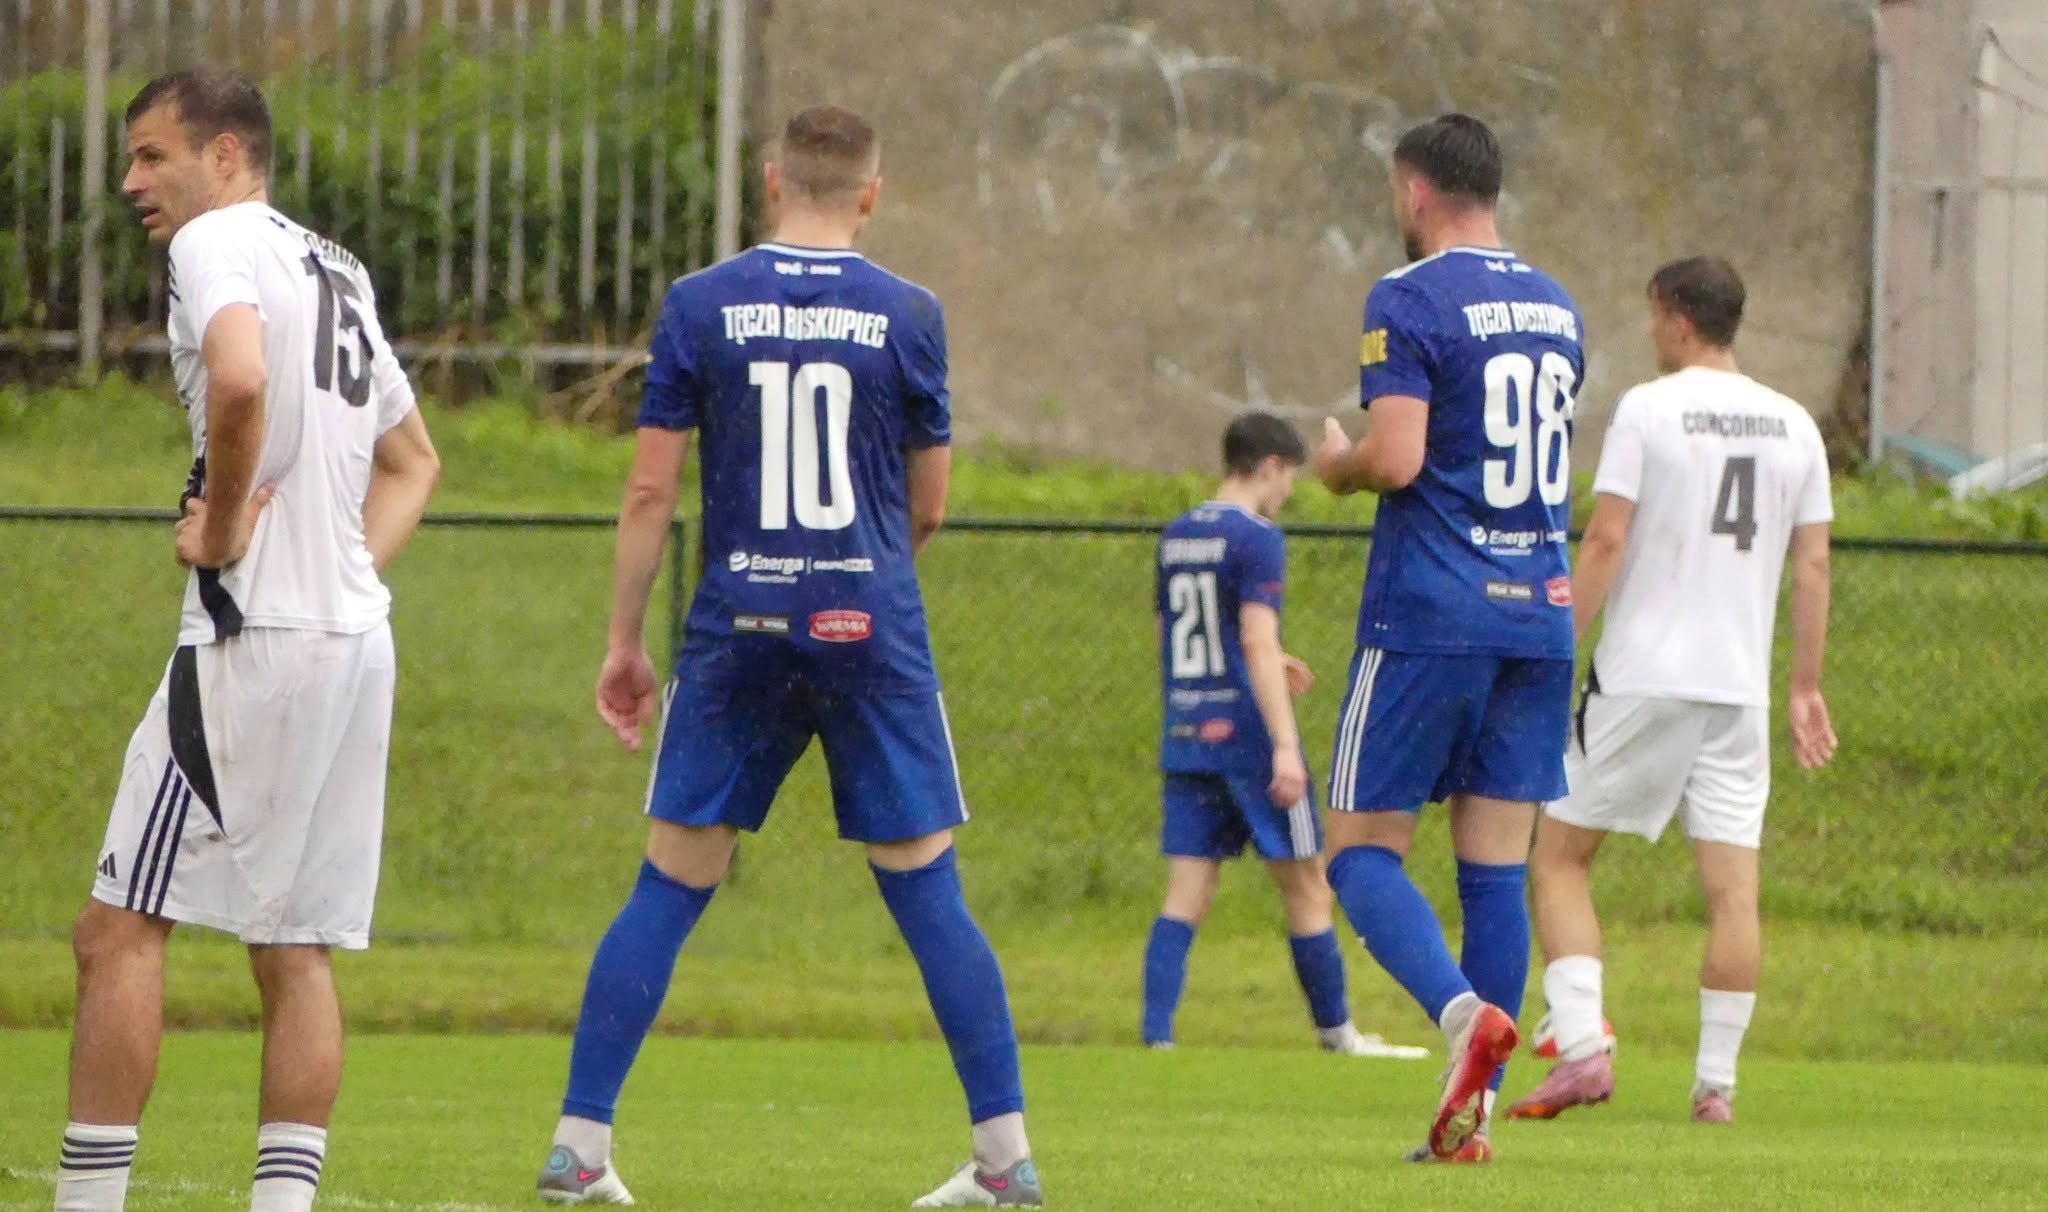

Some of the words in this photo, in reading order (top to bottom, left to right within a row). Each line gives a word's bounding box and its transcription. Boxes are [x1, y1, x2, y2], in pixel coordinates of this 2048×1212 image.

[300, 250, 375, 408] 15
[721, 303, 781, 345] TĘCZA
[785, 306, 888, 348] BISKUPIEC
[1462, 301, 1512, 342] TĘCZA
[748, 361, 856, 530] 10
[1483, 351, 1577, 509] 98
[1682, 410, 1789, 440] CONCORDIA
[1711, 456, 1758, 551] 4
[751, 554, 804, 574] Energa
[1168, 571, 1226, 680] 21
